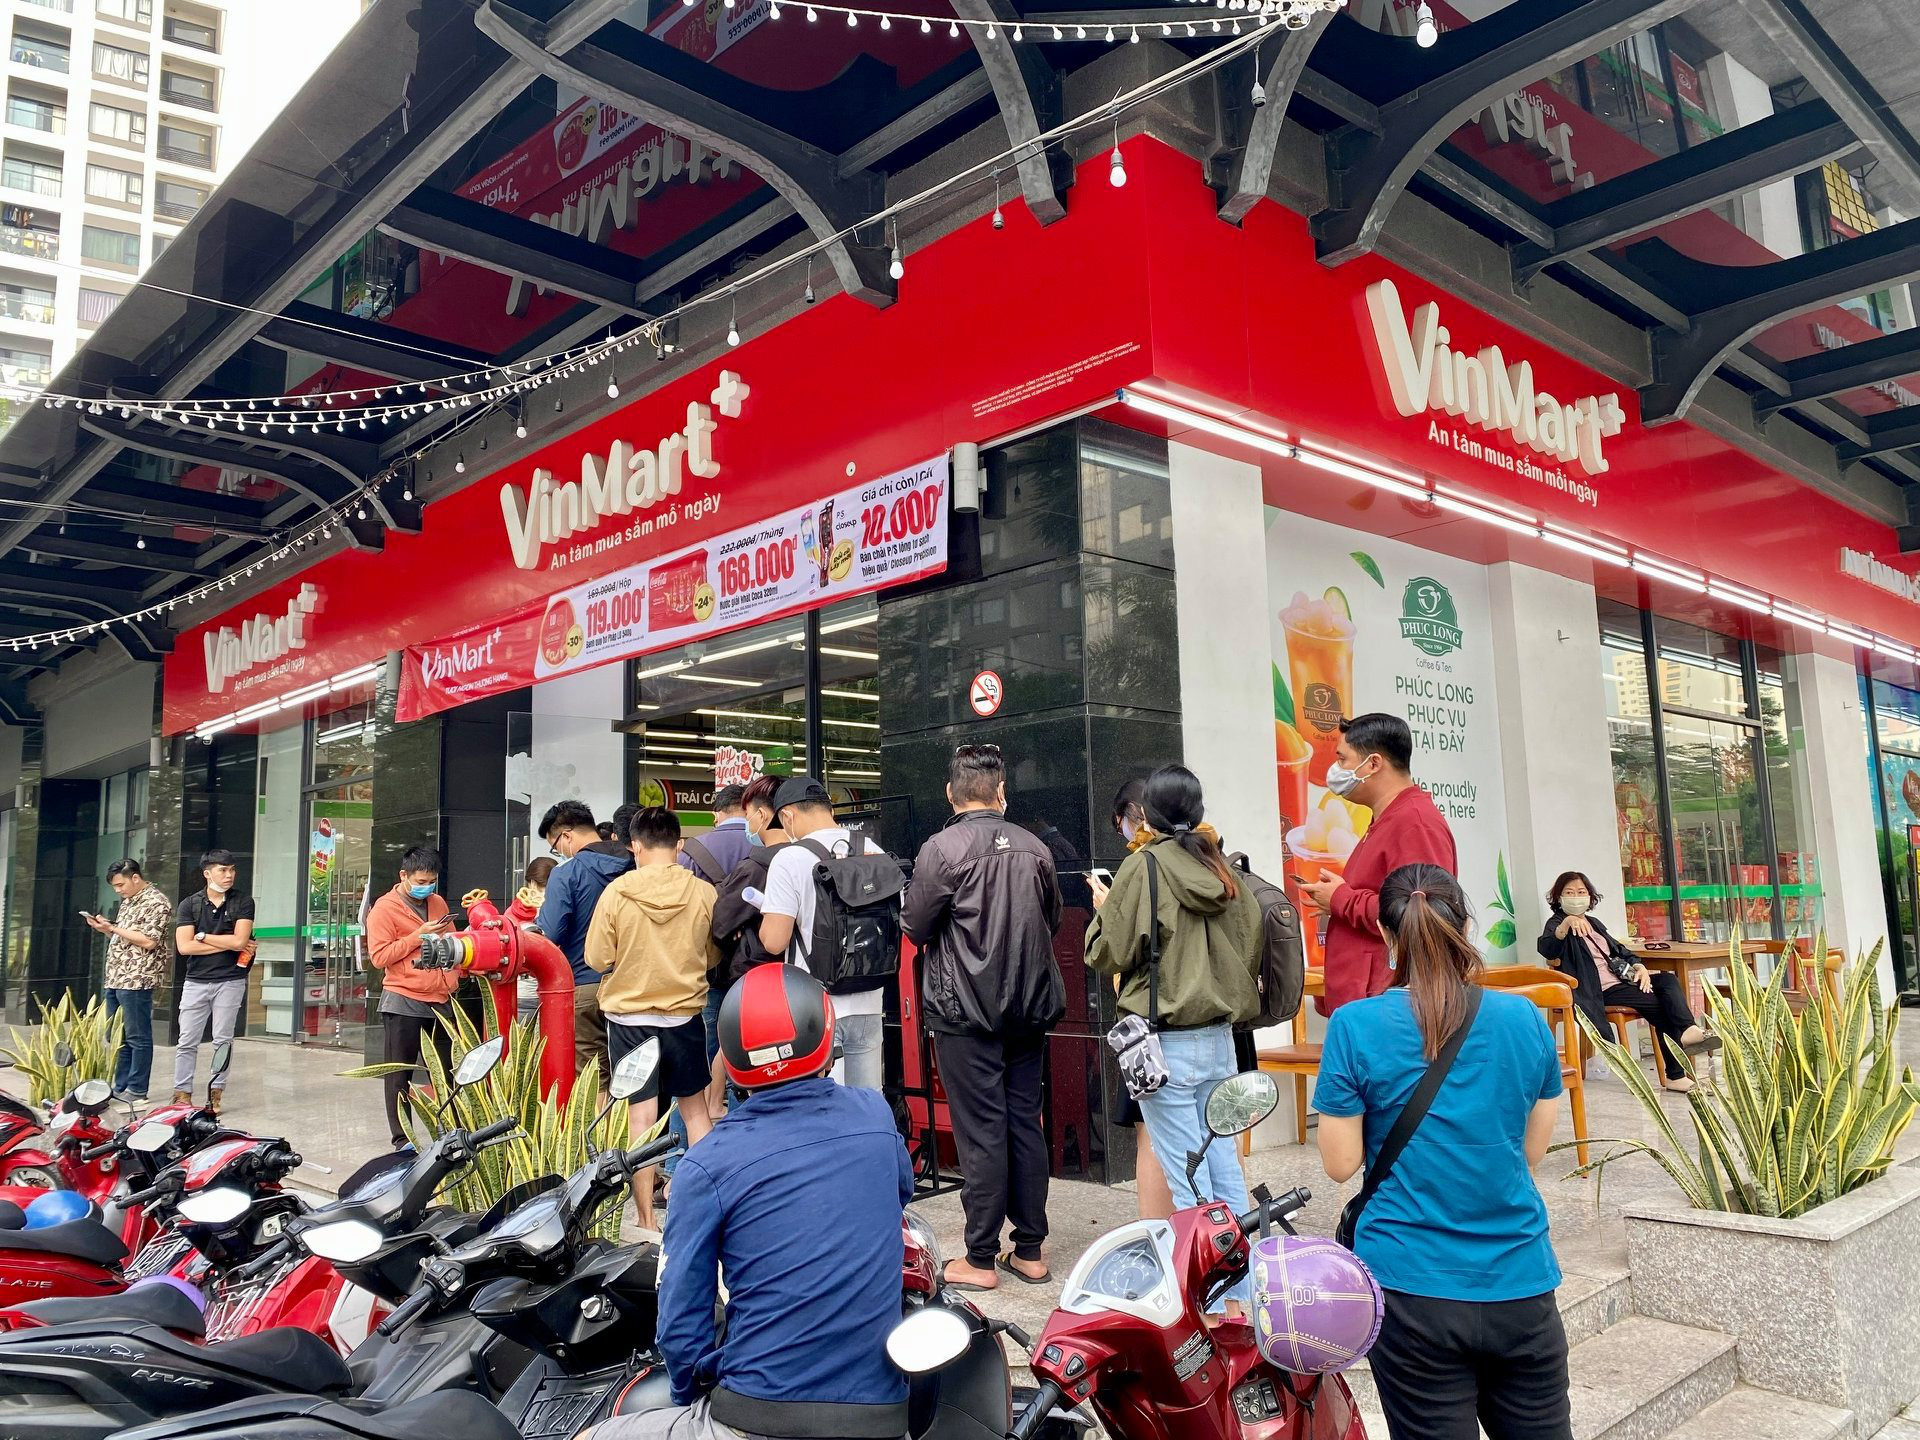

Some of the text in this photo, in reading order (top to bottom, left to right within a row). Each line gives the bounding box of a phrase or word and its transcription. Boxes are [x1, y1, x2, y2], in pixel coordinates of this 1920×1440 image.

[1428, 420, 1598, 508] An tâm mua sắm mỗi ngày
[861, 486, 877, 503] Giá
[879, 480, 893, 497] chỉ
[550, 553, 567, 571] An
[569, 541, 593, 564] tâm
[595, 530, 622, 550] mua
[625, 515, 653, 541] sắm
[685, 493, 721, 522] ngày
[1402, 621, 1460, 645] PHUC LONG
[1395, 675, 1474, 705] PHÚC LONG
[1407, 703, 1466, 733] PHỤC VỤ
[1412, 729, 1465, 754] TẠI ĐÂY
[675, 790, 699, 804] TRÁI
[1431, 780, 1477, 802] proudly
[1449, 800, 1476, 819] here
[0, 1278, 54, 1289] LADE
